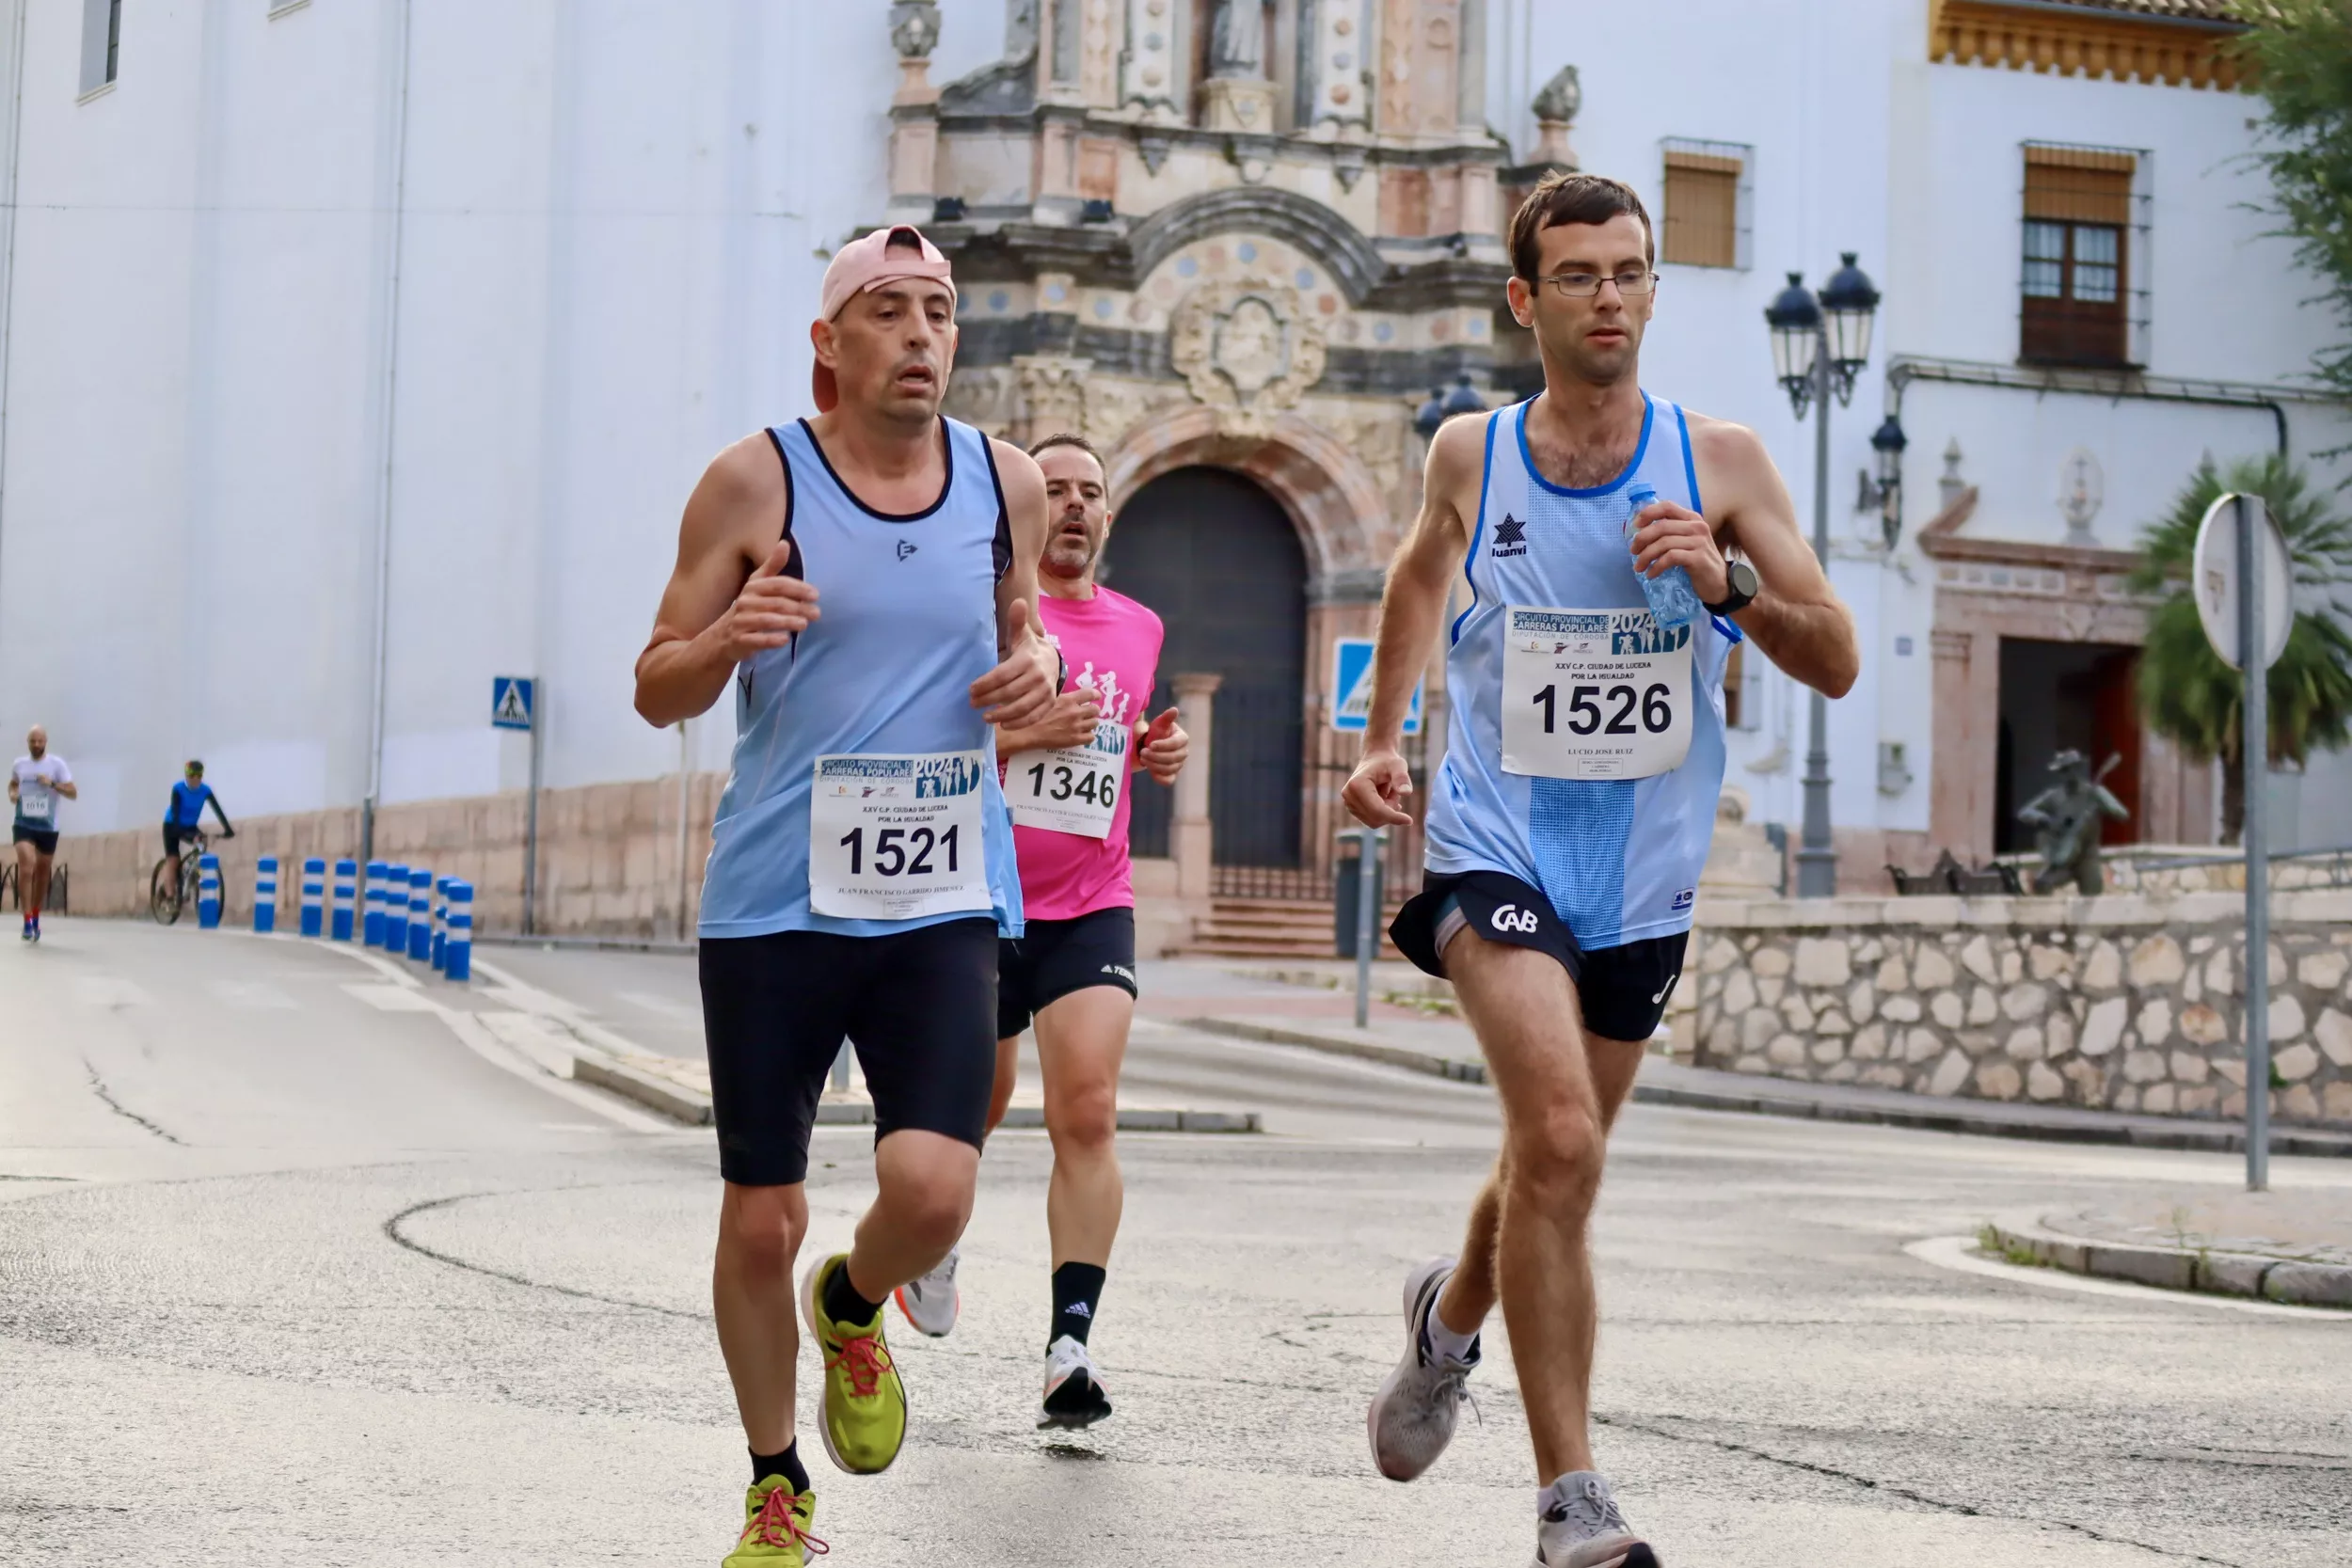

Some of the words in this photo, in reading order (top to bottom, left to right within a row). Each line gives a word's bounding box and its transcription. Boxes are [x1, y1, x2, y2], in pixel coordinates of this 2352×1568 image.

[1492, 545, 1527, 558] luanvi
[1513, 621, 1557, 631] CARRERAS
[1559, 623, 1609, 633] POPULARES
[1514, 611, 1549, 622] CIRCUITO
[1550, 614, 1597, 625] PROVINCIAL
[1599, 616, 1609, 625] DE
[1610, 613, 1656, 634] 2024
[1533, 683, 1673, 736] 1526
[857, 760, 903, 768] PROVINCIAL
[866, 768, 914, 778] POPULARES
[914, 757, 954, 778] 2024
[1027, 762, 1115, 808] 1346
[840, 824, 959, 877] 1521
[1491, 904, 1538, 934] CAB
